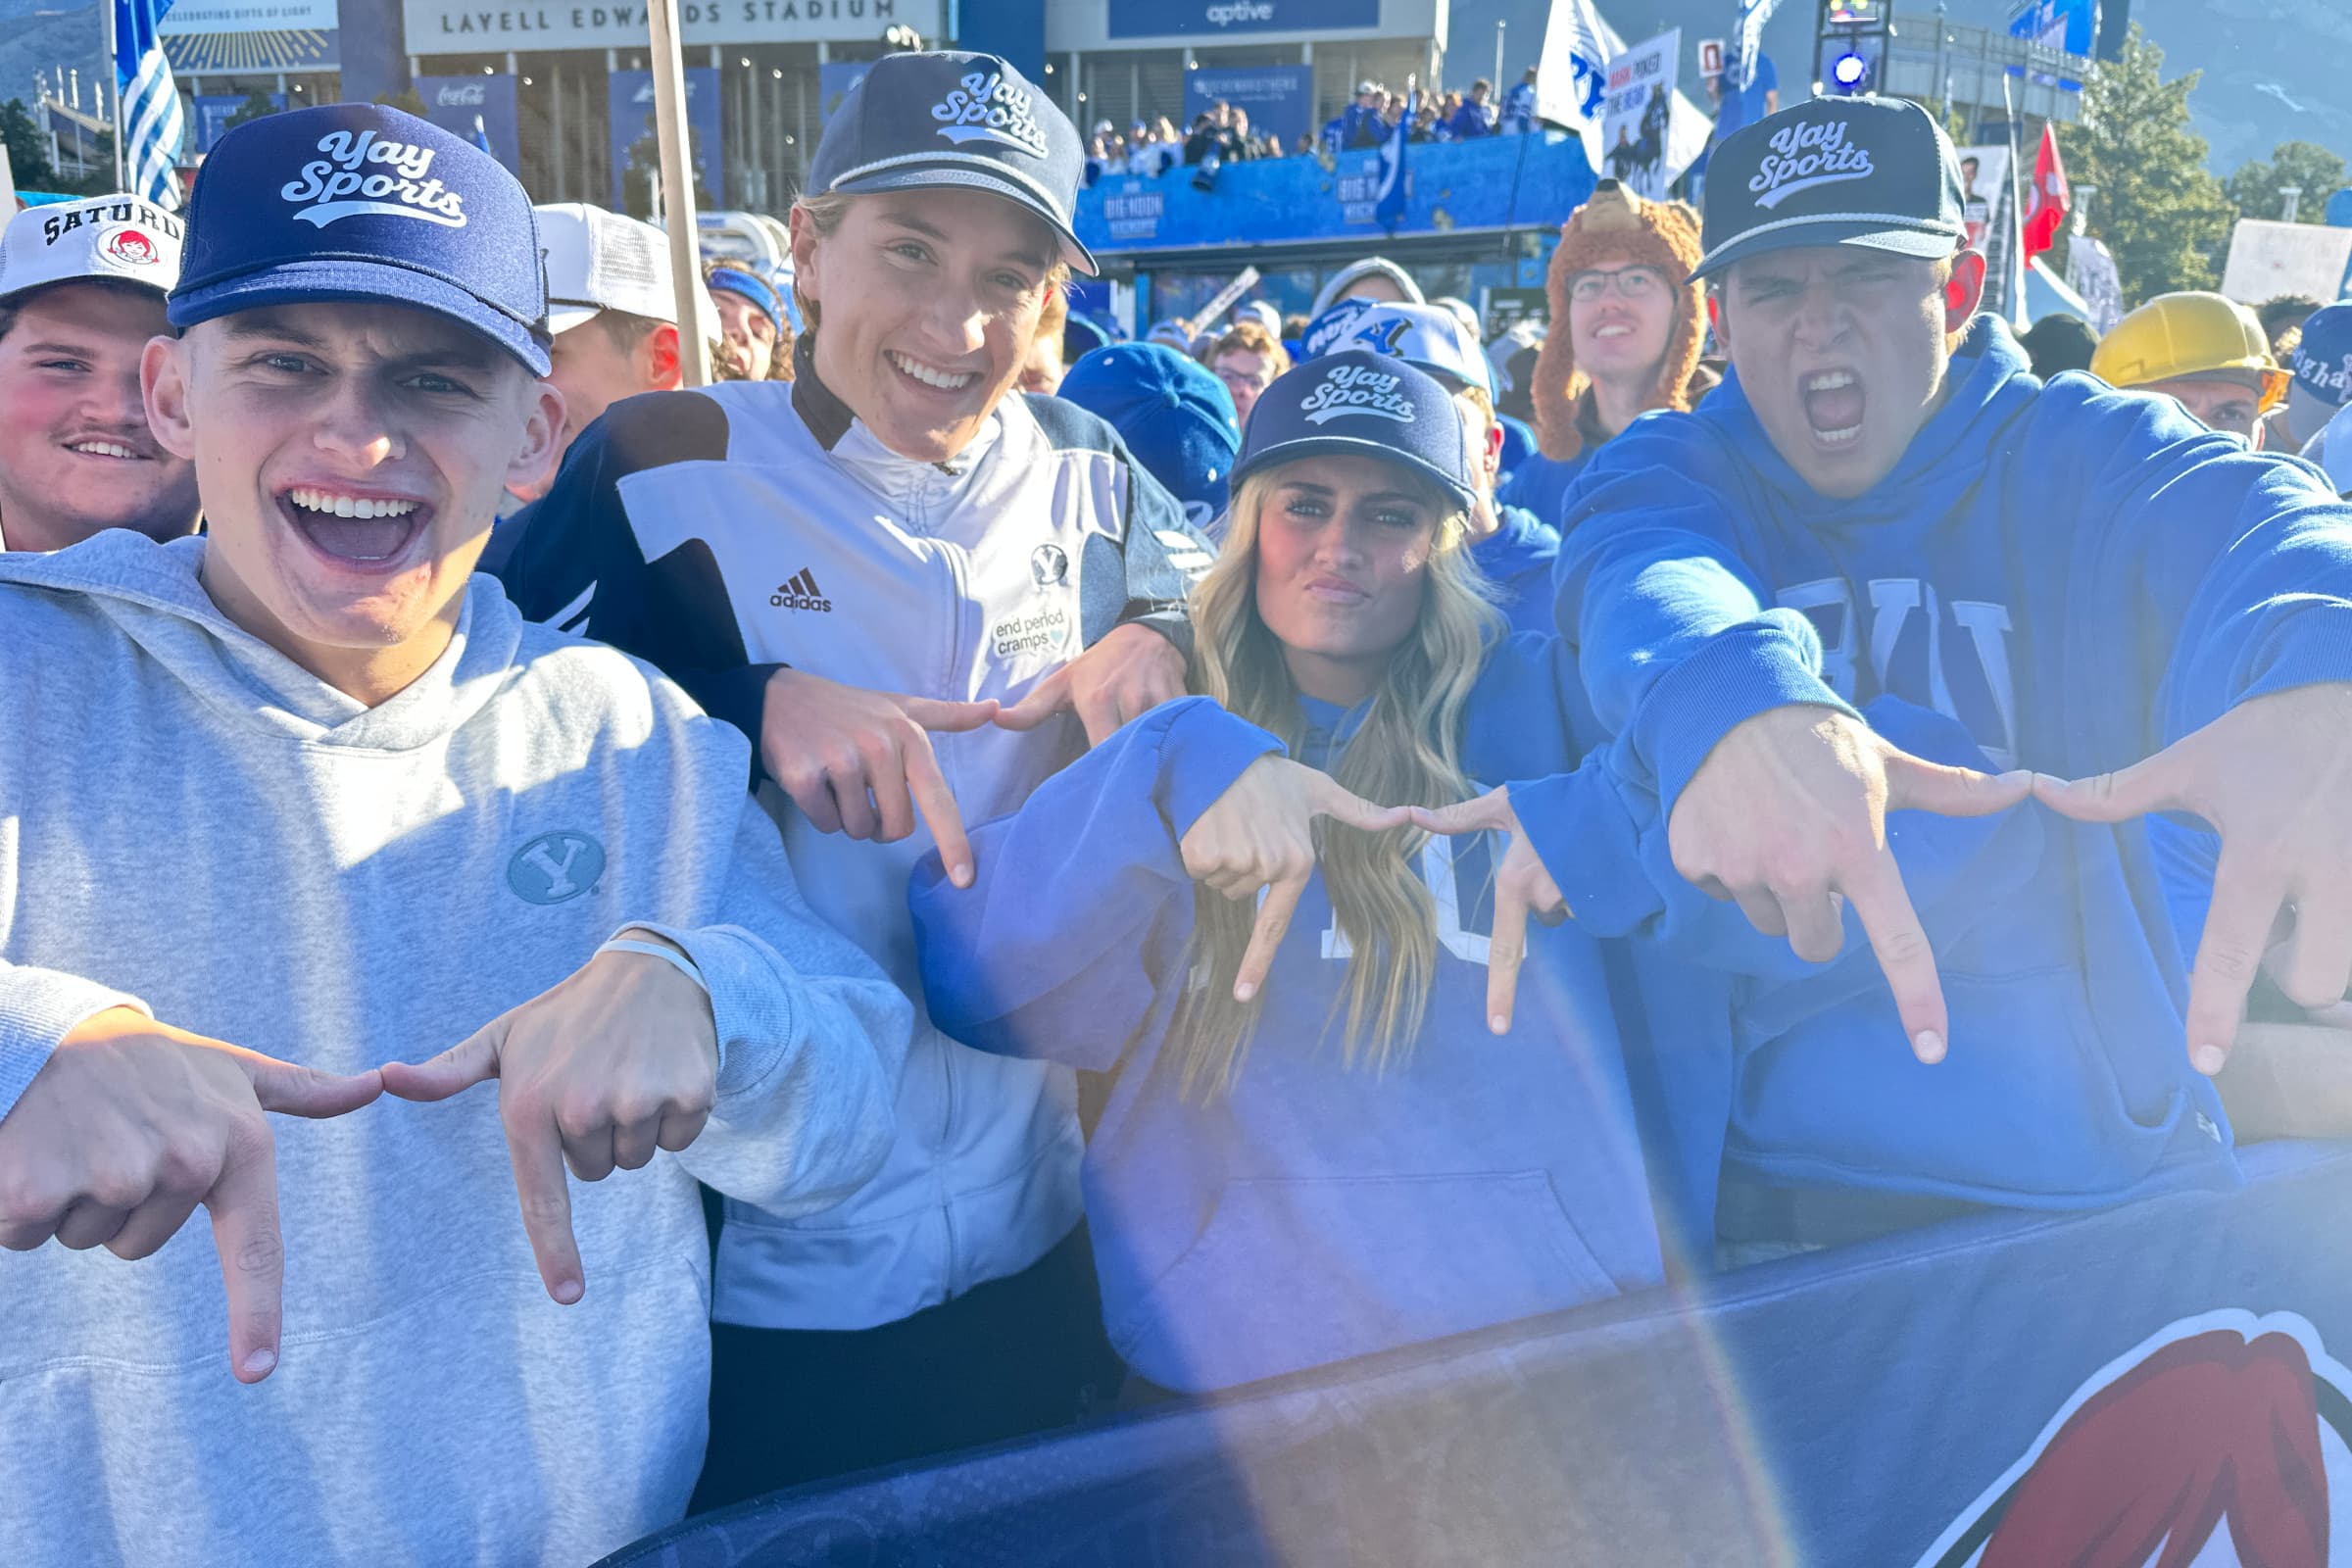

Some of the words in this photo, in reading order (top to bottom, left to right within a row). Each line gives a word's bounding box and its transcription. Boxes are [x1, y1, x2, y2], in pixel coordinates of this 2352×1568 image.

[960, 73, 1032, 118] Yay
[931, 90, 1046, 150] Sports
[318, 130, 435, 180] Yay
[1770, 122, 1848, 160] Yay
[1749, 147, 1873, 192] Sports
[281, 161, 465, 217] Sports
[1328, 366, 1400, 394] Yay
[1301, 383, 1415, 416] Sports
[769, 594, 832, 612] adidas
[997, 617, 1021, 637] end
[1024, 607, 1064, 635] period
[998, 633, 1049, 655] cramps
